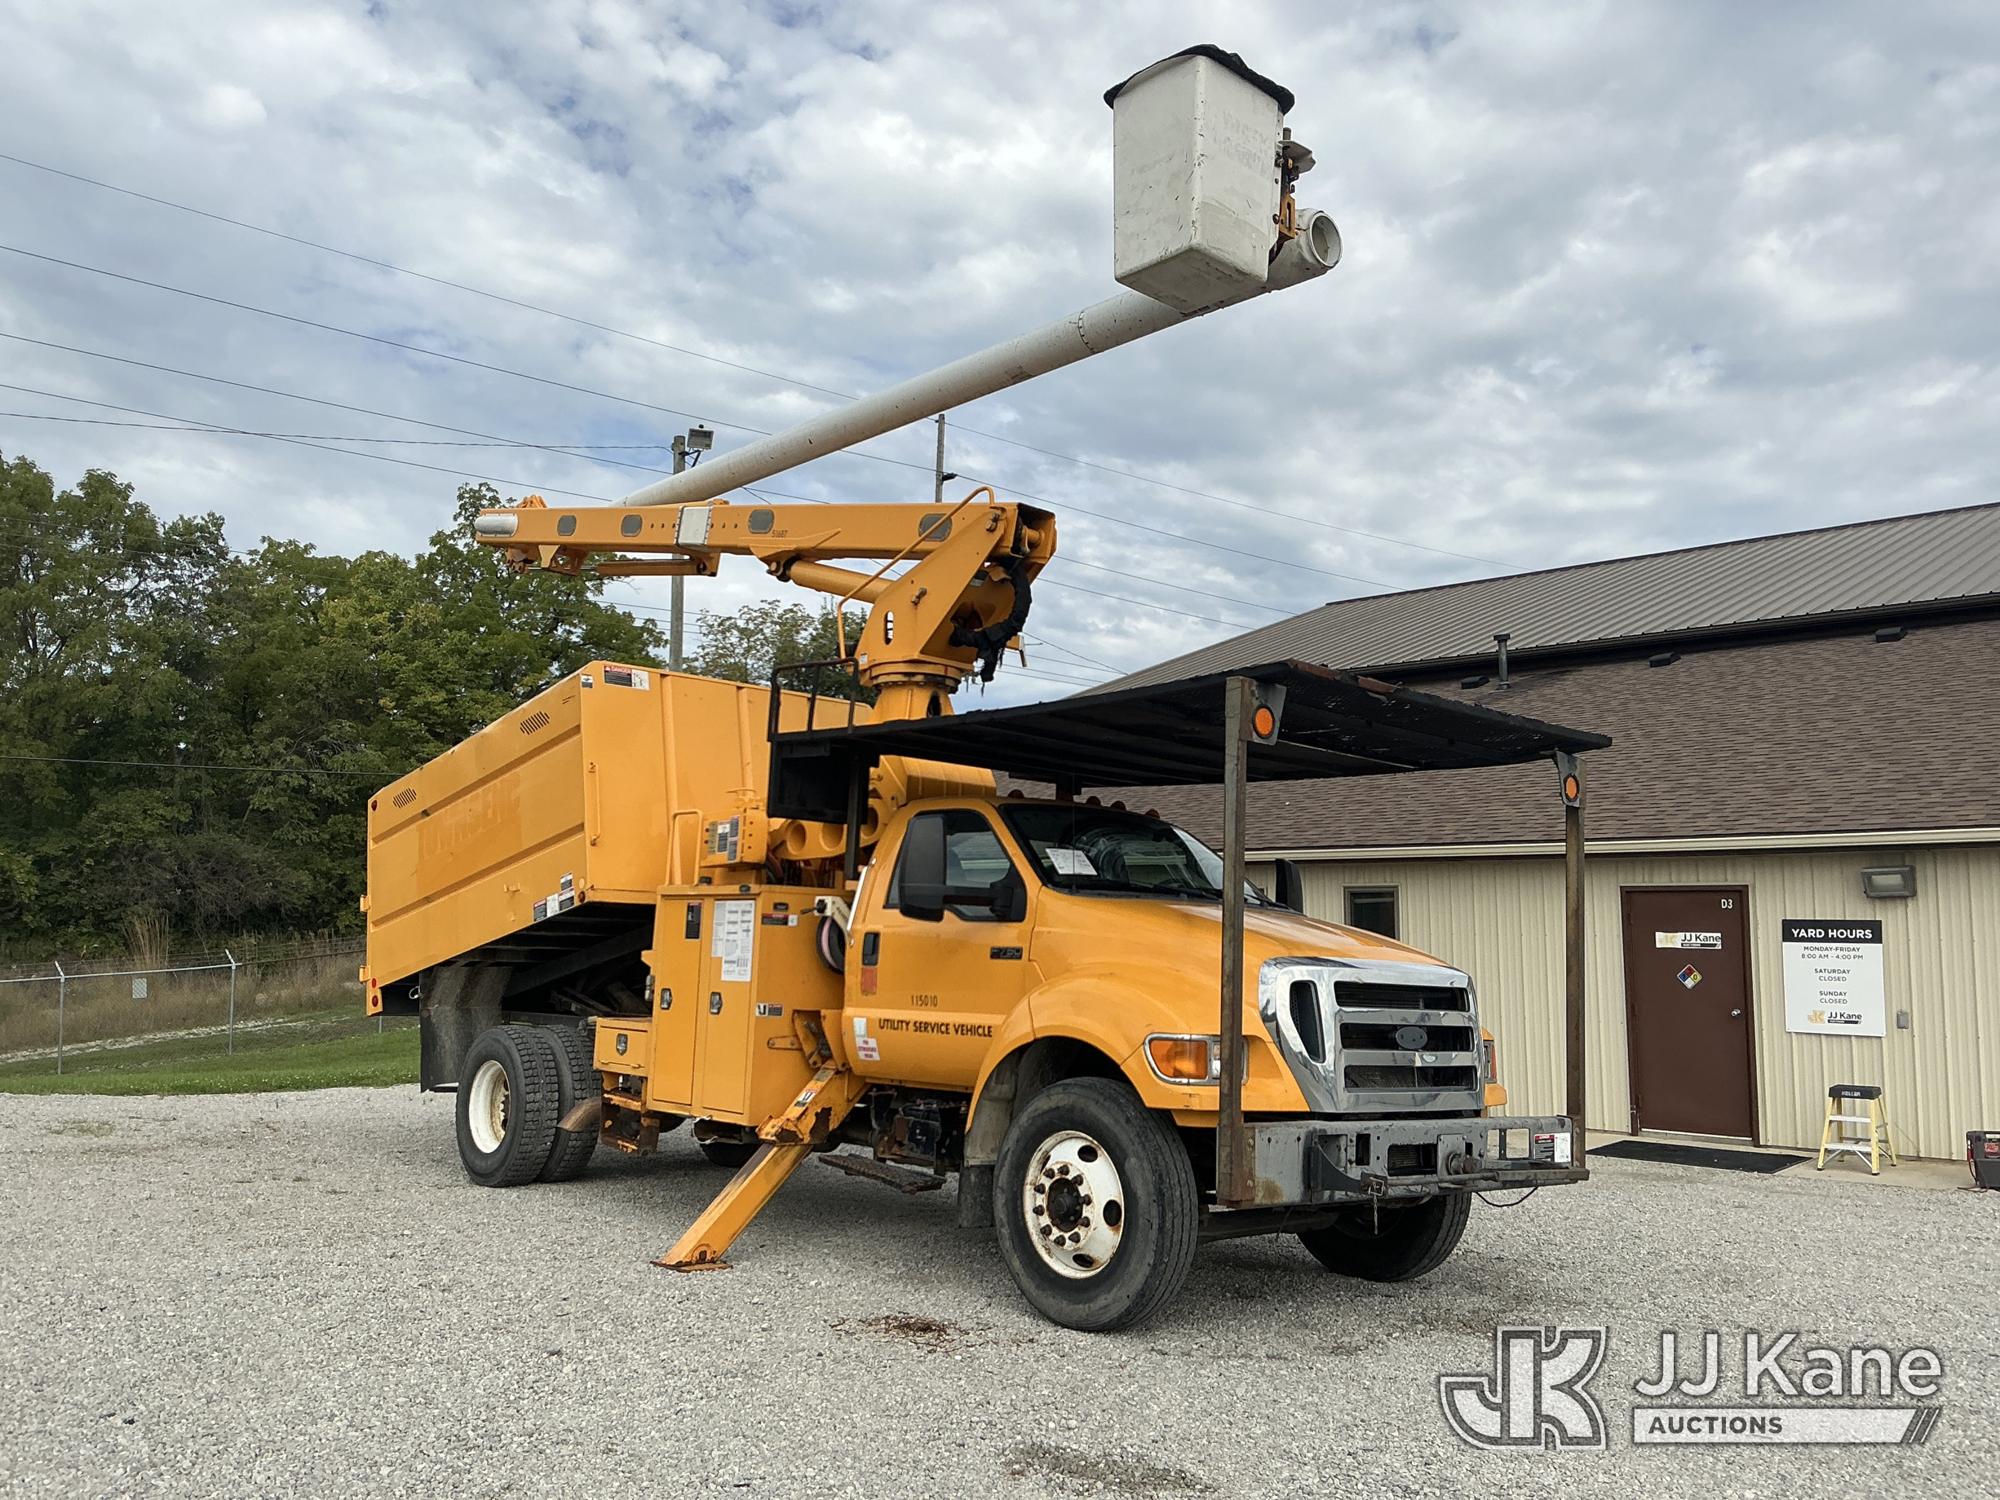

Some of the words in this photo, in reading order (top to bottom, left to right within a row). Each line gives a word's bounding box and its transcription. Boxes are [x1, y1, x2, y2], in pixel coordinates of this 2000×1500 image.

[1721, 898, 1733, 909] D3
[1681, 933, 1692, 942] JJ
[1695, 933, 1721, 942] Kane
[1791, 928, 1825, 938] YARD
[1828, 929, 1873, 939] HOURS
[911, 994, 938, 1007] 115010
[1827, 1011, 1838, 1019] JJ
[1839, 1011, 1863, 1020] Kane
[878, 1018, 911, 1032] UTILITY
[913, 1020, 951, 1036] SERVICE
[953, 1023, 993, 1038] VEHICLE
